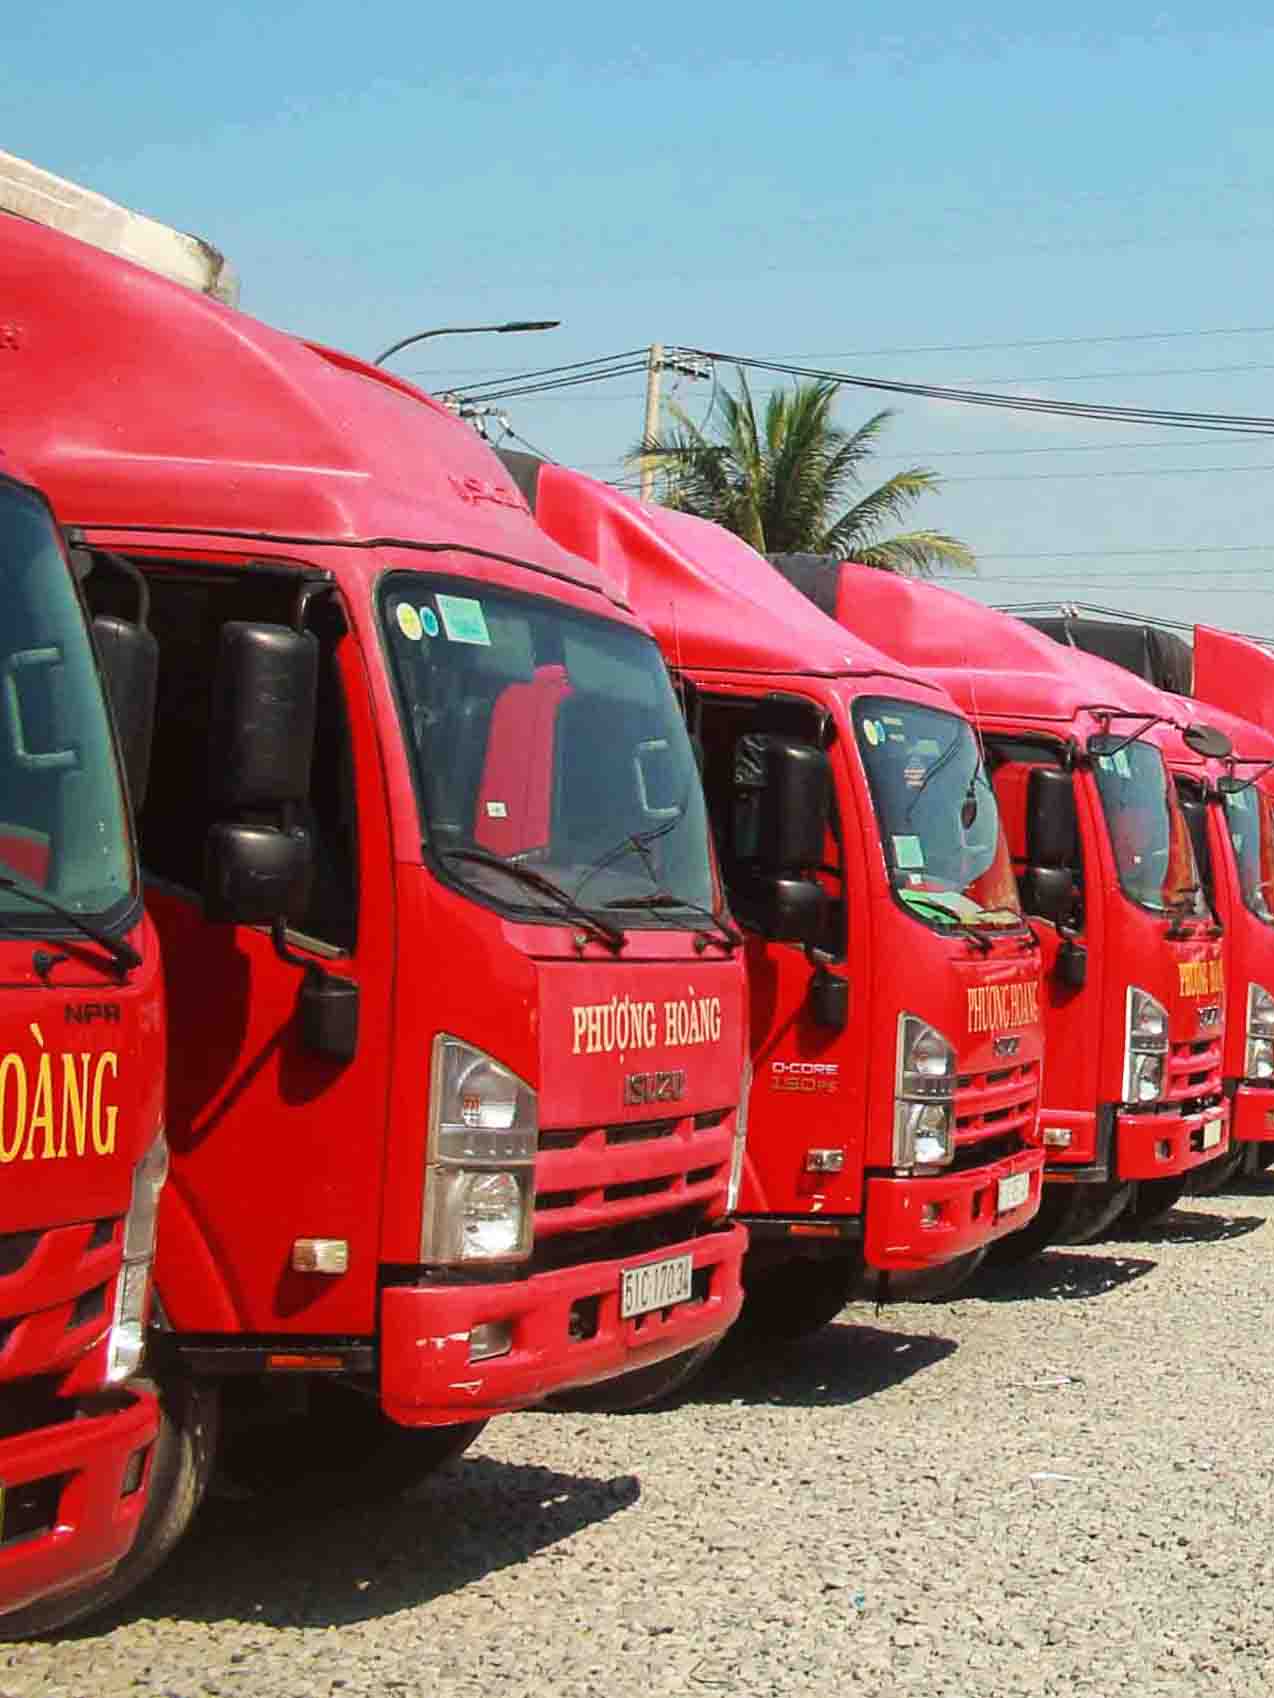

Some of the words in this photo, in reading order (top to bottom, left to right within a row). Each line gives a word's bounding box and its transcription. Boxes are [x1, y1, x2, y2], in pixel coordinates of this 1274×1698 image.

[64, 1003, 121, 1024] NPR
[572, 994, 657, 1065] PHƯỢNG
[663, 984, 721, 1046] HOÀNG
